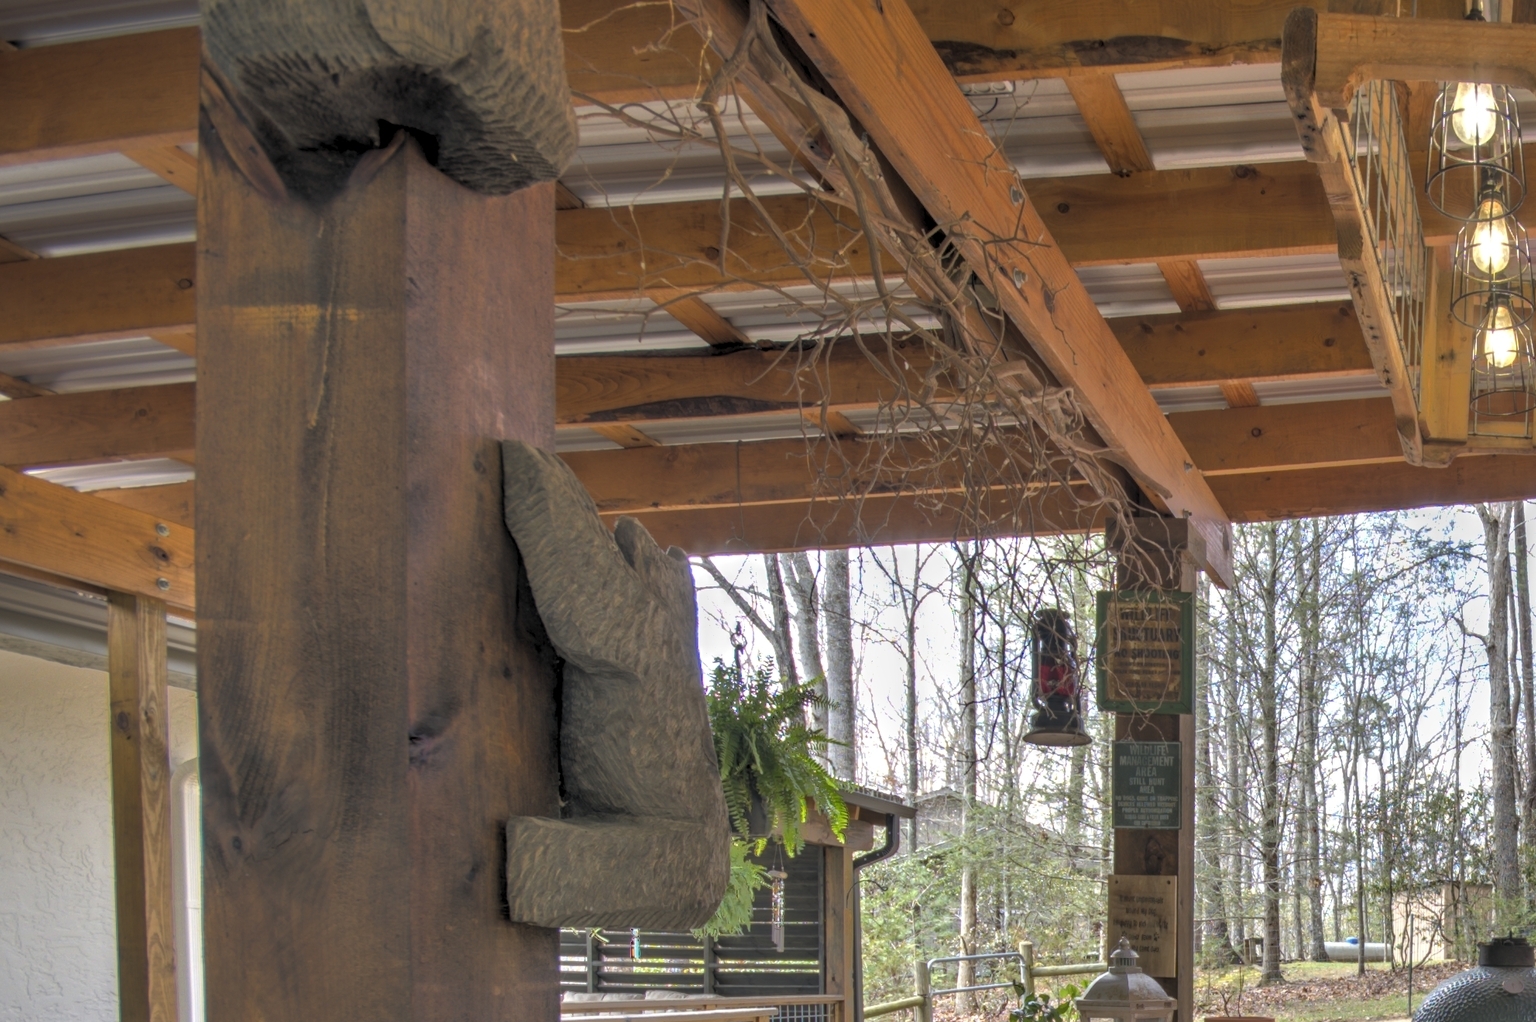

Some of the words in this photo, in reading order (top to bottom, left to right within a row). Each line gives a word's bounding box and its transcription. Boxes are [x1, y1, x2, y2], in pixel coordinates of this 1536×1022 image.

[1131, 648, 1180, 660] SHOOTING
[1130, 745, 1166, 756] WILDLIFE
[1119, 756, 1174, 767] MANAGEMENT
[1135, 766, 1157, 777] AREA
[1129, 777, 1146, 786] STILL
[1139, 786, 1155, 794] AREA
